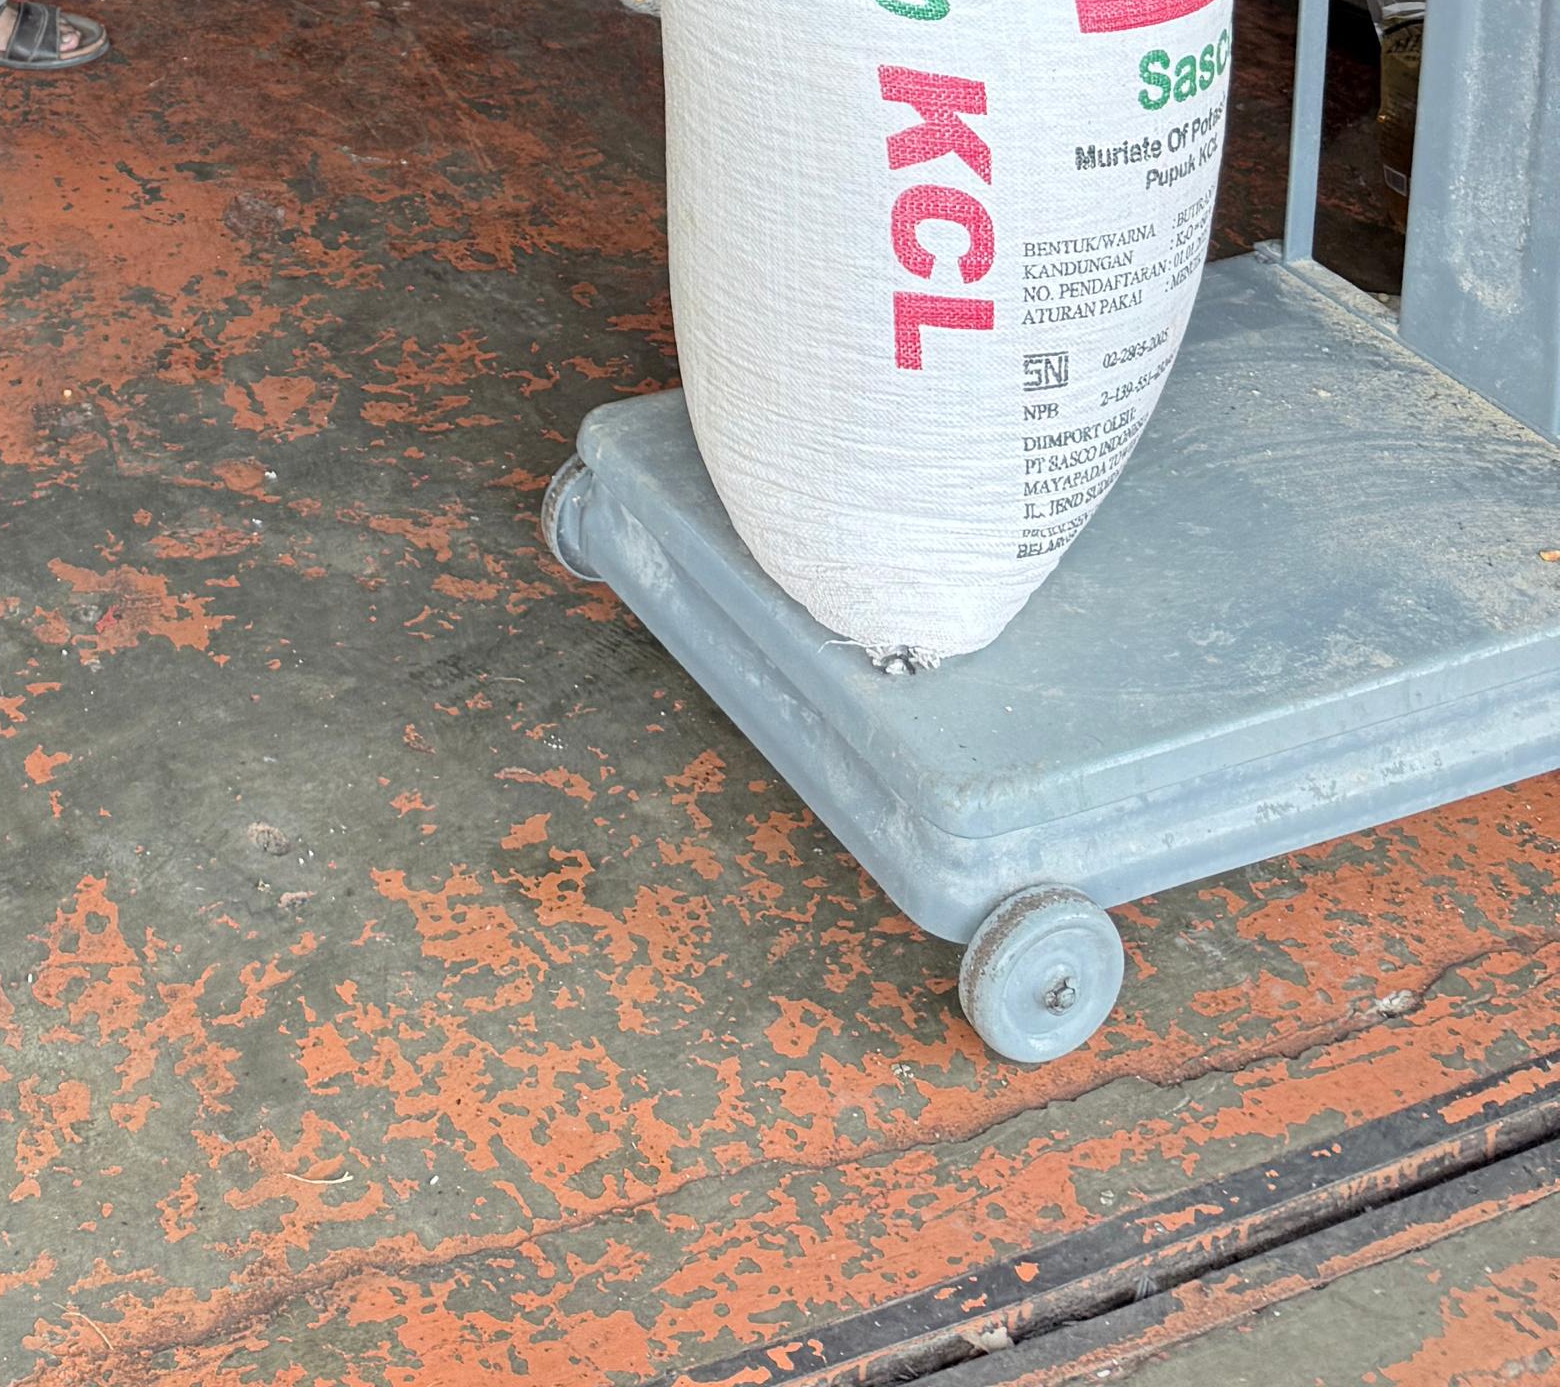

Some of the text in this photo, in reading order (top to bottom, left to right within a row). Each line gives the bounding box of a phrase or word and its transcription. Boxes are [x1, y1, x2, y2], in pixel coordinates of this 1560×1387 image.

[1138, 28, 1230, 112] Sasc
[1075, 136, 1162, 171] Muriate
[1167, 122, 1190, 154] Of
[1145, 153, 1196, 191] Pupuk
[877, 64, 997, 372] KCL
[1022, 223, 1158, 258] BENTUK/WARNA
[1022, 249, 1135, 280] KANDUNGAN
[1021, 289, 1144, 325] ATURAN PAKAI
[1023, 285, 1055, 303] NO.
[1022, 353, 1070, 388] SNI
[1023, 402, 1060, 422] NPB
[1024, 444, 1097, 476] PT SASCO
[1048, 491, 1085, 518] JEND
